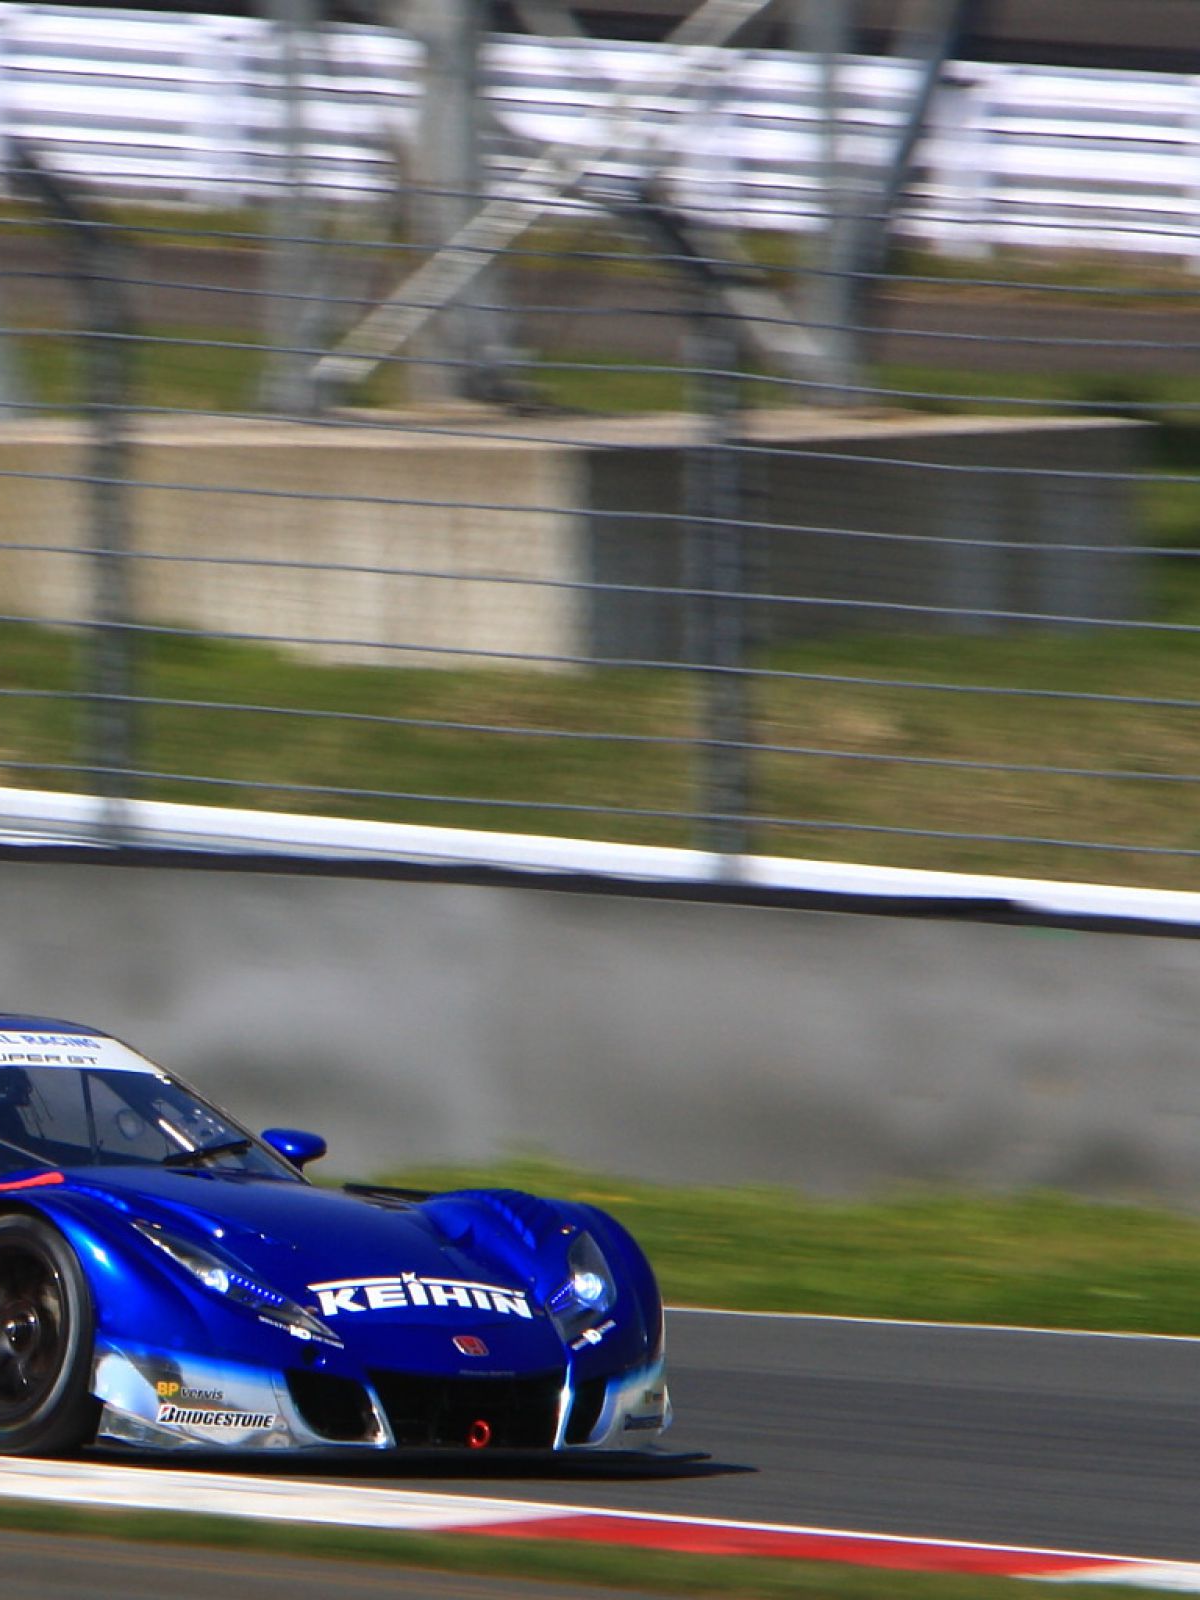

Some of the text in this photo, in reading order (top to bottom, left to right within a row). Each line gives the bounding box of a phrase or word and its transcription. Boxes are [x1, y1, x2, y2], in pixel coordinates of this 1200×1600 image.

[20, 1034, 101, 1049] RACING
[315, 1281, 533, 1319] KEIHIN
[155, 1381, 181, 1397] BP
[158, 1406, 275, 1428] BRIDGESTONE
